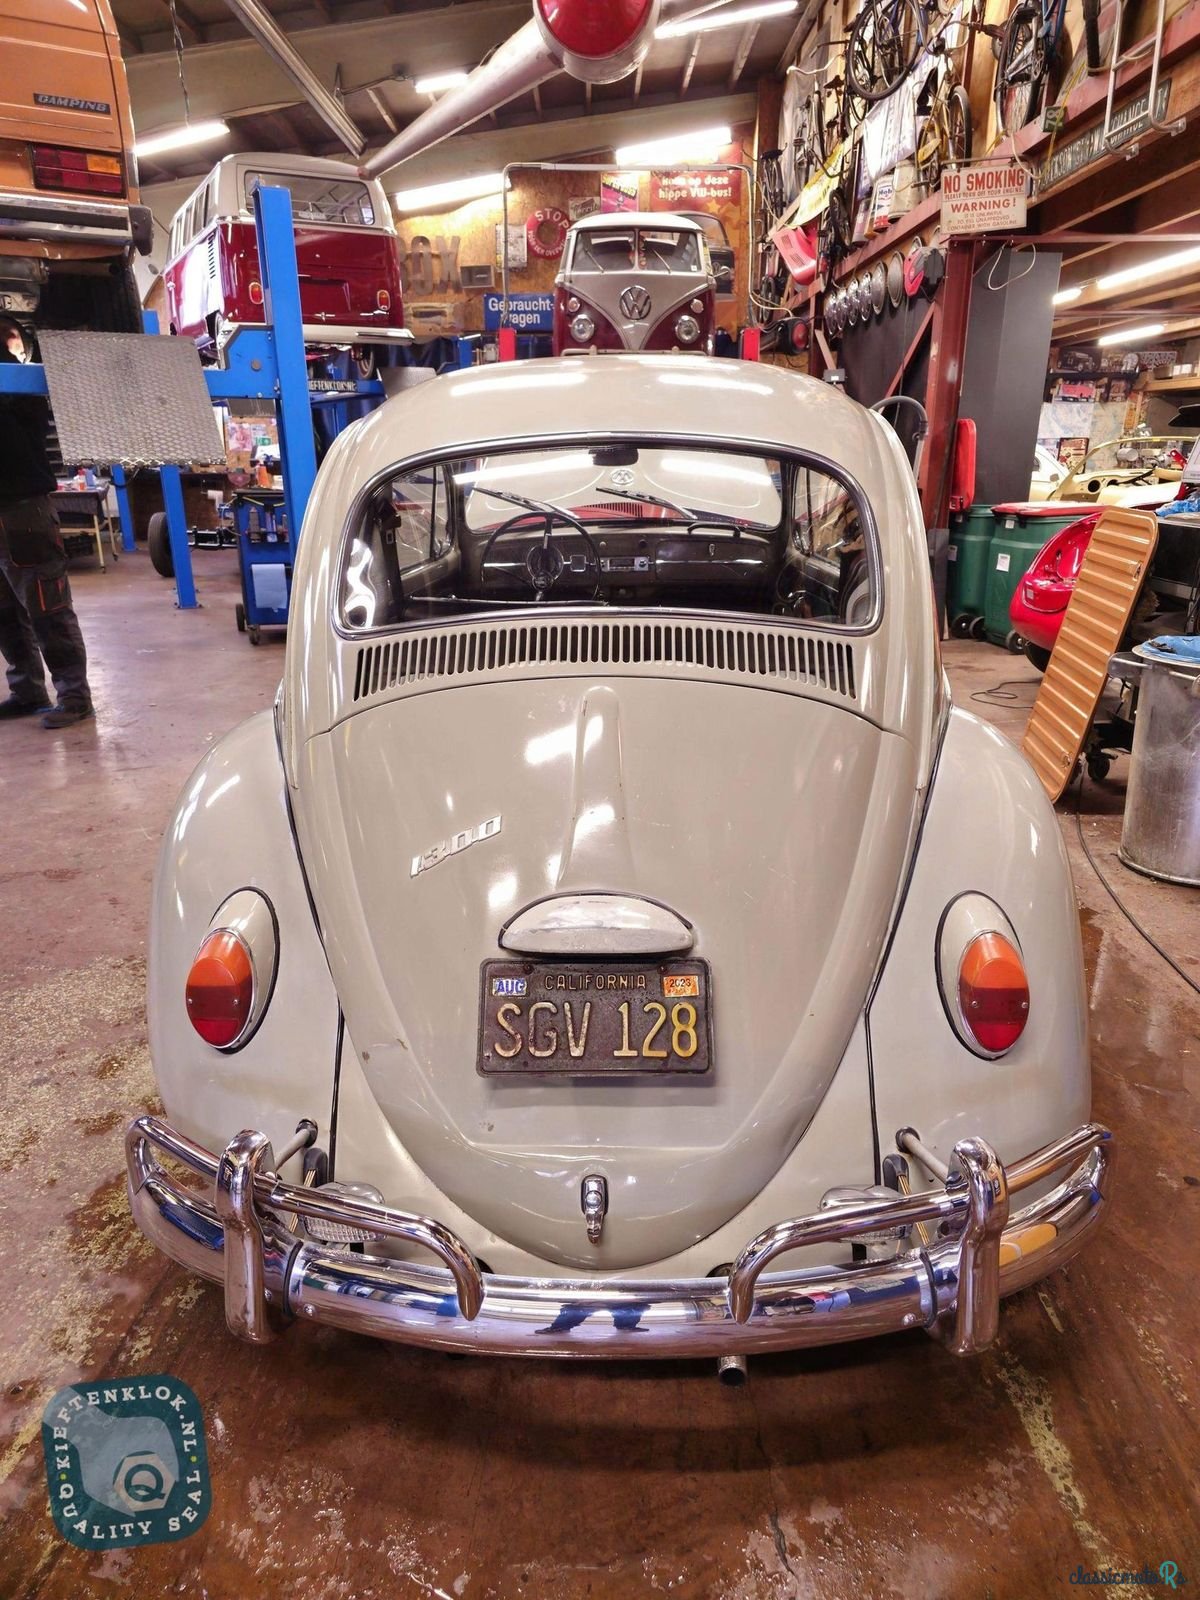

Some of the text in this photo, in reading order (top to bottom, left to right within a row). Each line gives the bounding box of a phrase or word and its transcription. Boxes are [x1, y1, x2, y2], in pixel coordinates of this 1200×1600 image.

[37, 94, 107, 113] CAMPING
[704, 174, 729, 186] deze
[944, 168, 1025, 194] NO SMOKING
[658, 187, 688, 201] hippe
[535, 207, 569, 229] STOP
[495, 974, 691, 994] AUG CALIFORNIA 2023
[494, 1001, 698, 1058] SGV 128
